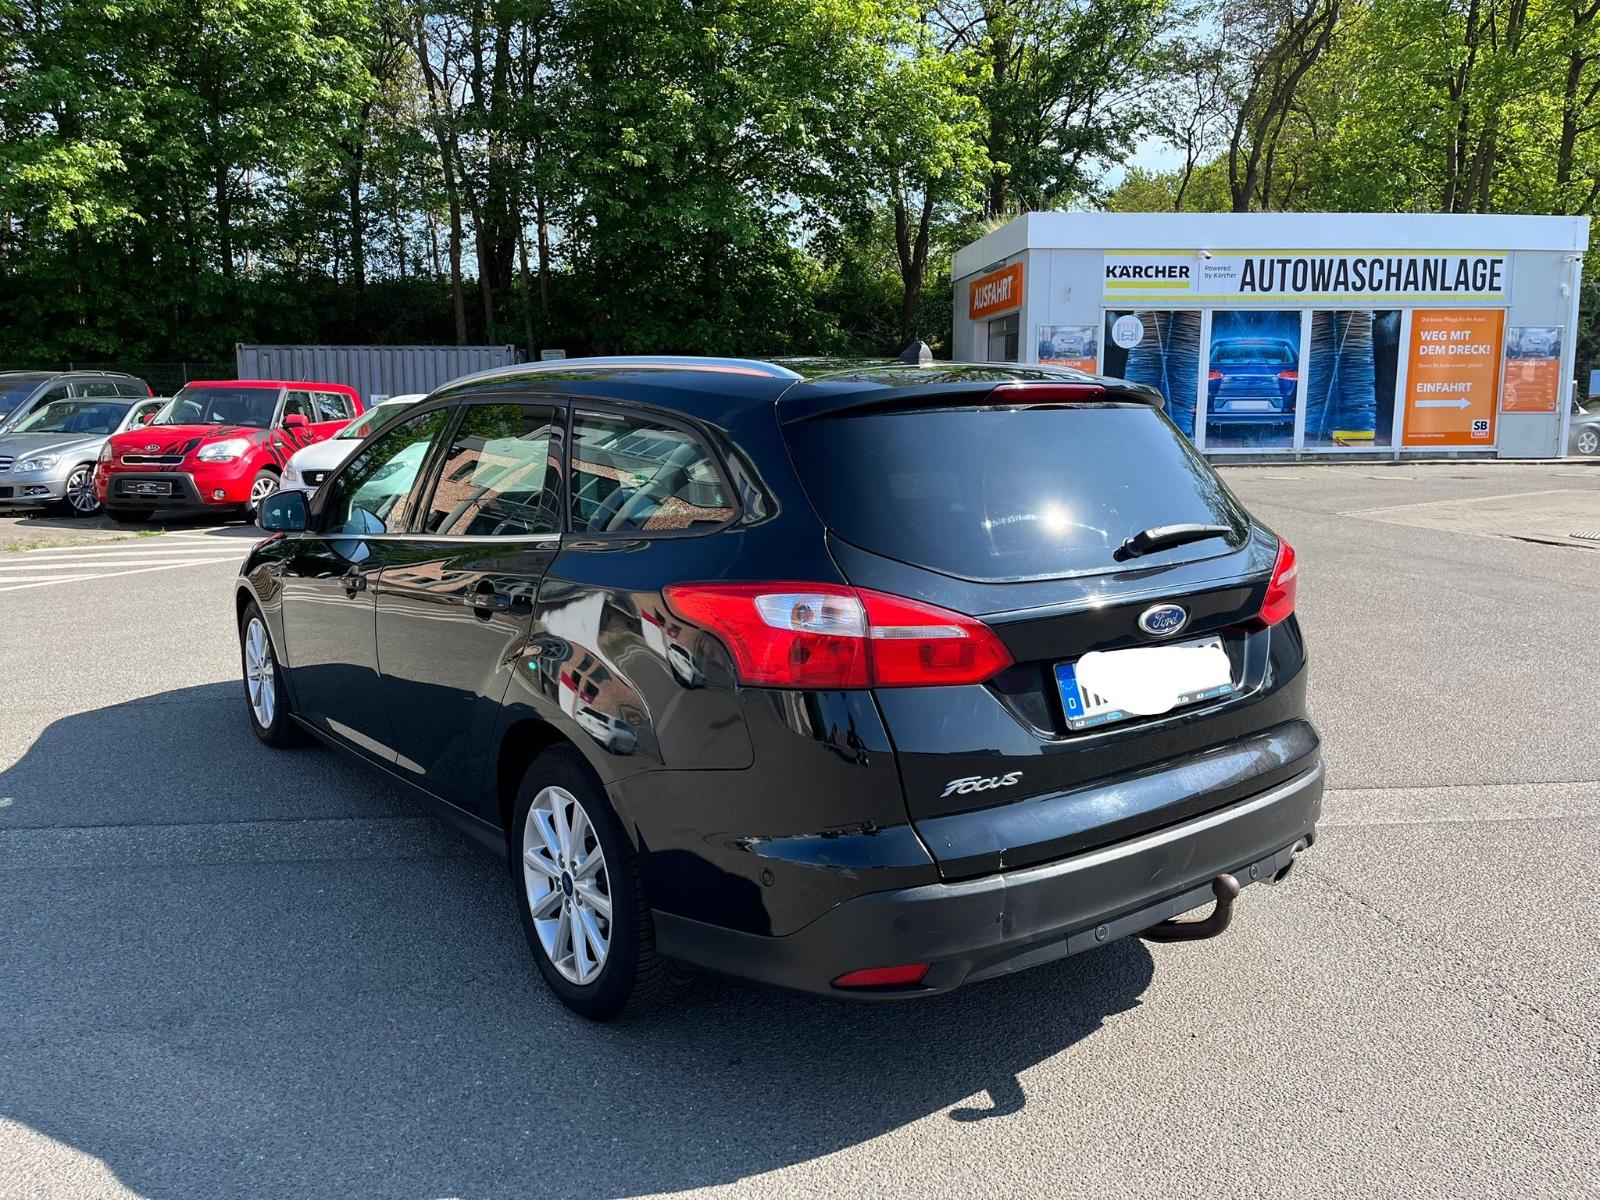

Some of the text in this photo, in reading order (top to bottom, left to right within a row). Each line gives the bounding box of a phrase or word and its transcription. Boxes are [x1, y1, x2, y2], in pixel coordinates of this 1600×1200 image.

[1106, 264, 1190, 279] KÄRCHER
[1239, 258, 1503, 292] AUTOWASCHANLAGE
[973, 275, 1013, 310] AUSFAHRT
[1420, 330, 1471, 341] WEG MIT
[1419, 344, 1490, 355] DEM DRECK!
[1416, 382, 1473, 393] EINFAHRT
[1473, 420, 1488, 431] SB
[1152, 609, 1179, 629] Ford
[1069, 697, 1077, 709] D
